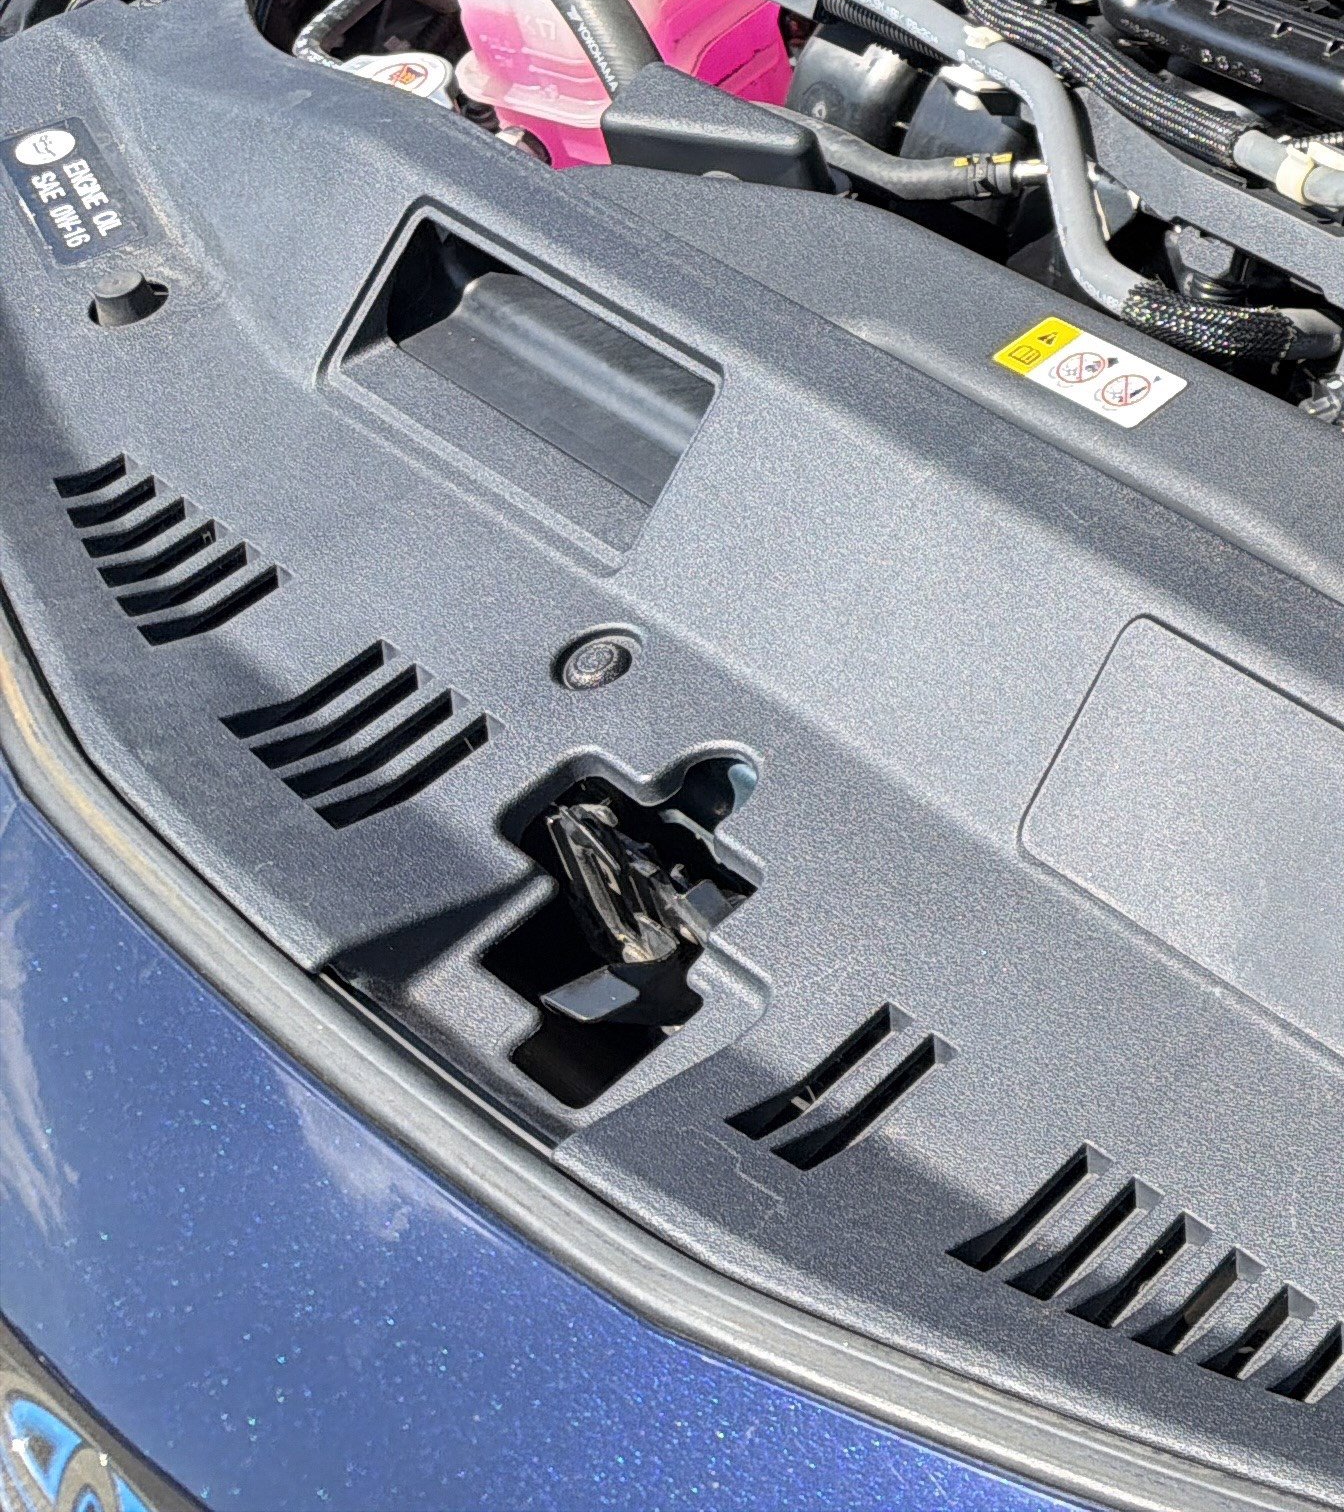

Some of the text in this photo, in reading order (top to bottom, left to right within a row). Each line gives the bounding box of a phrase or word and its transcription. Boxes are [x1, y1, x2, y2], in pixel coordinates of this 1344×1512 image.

[577, 24, 618, 91] YOKOHAMA
[32, 172, 91, 248] SAE 0W-16
[64, 159, 122, 237] ENGINE OIL
